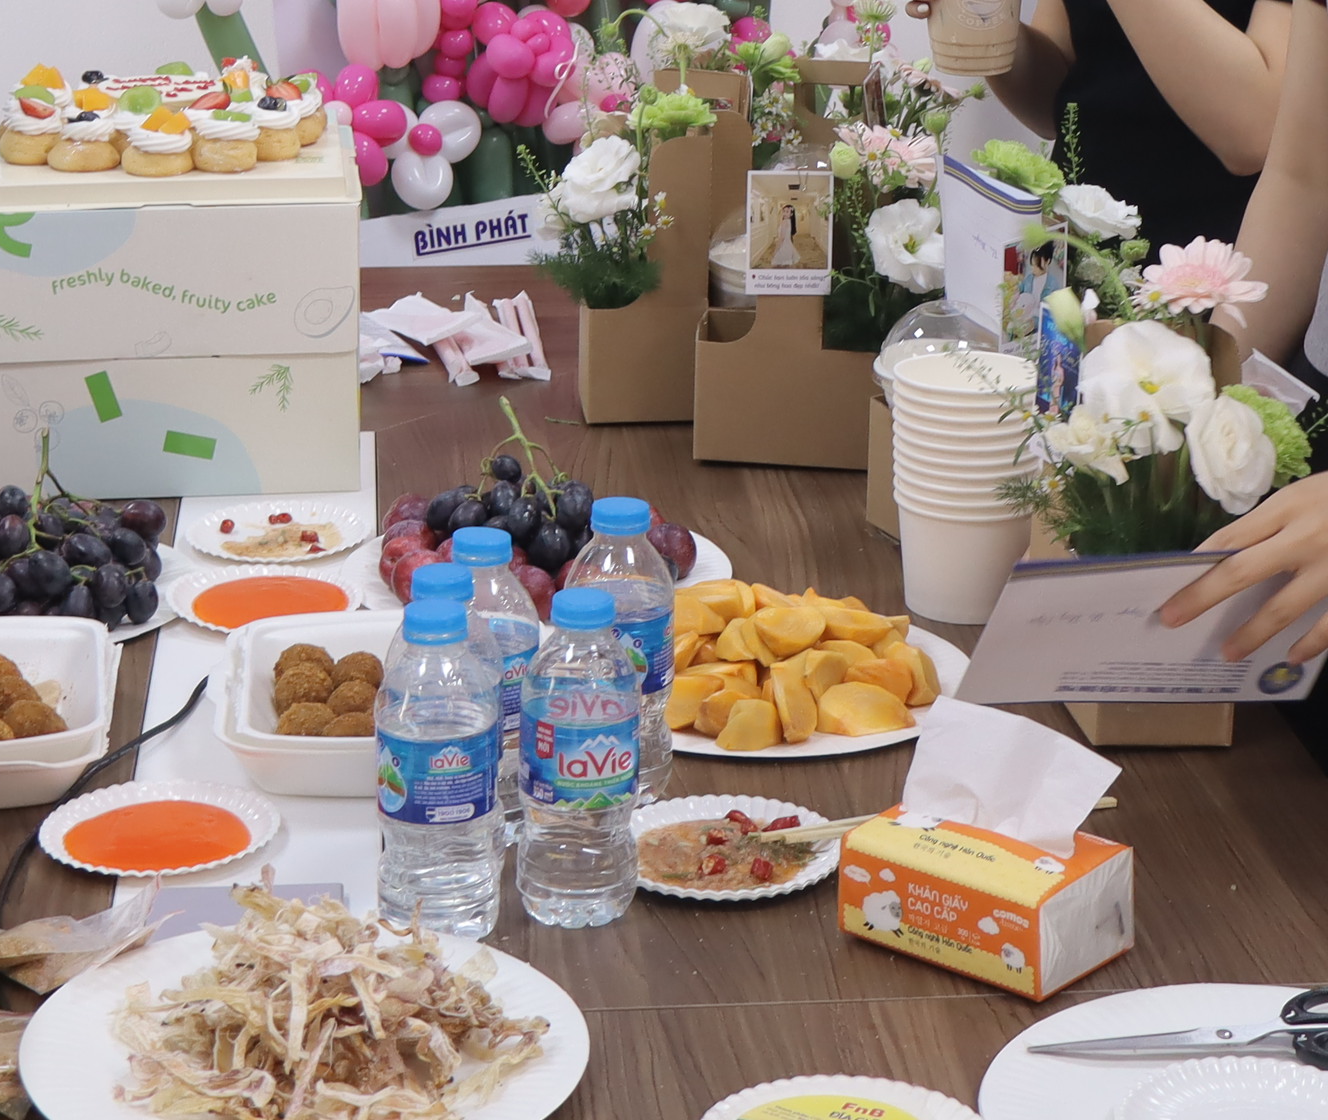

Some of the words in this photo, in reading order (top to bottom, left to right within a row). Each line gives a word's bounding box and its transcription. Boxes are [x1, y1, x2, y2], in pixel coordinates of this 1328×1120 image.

[414, 223, 468, 253] BÌNH
[475, 209, 529, 242] PHÁT
[52, 267, 115, 295] freshly
[120, 268, 176, 301] baked,
[181, 289, 231, 314] fruity
[236, 292, 277, 312] cake
[430, 752, 470, 769] laVie
[559, 747, 632, 778] laVie
[907, 897, 931, 915] CAO
[934, 905, 958, 923] CẤP
[841, 1102, 885, 1118] FnB
